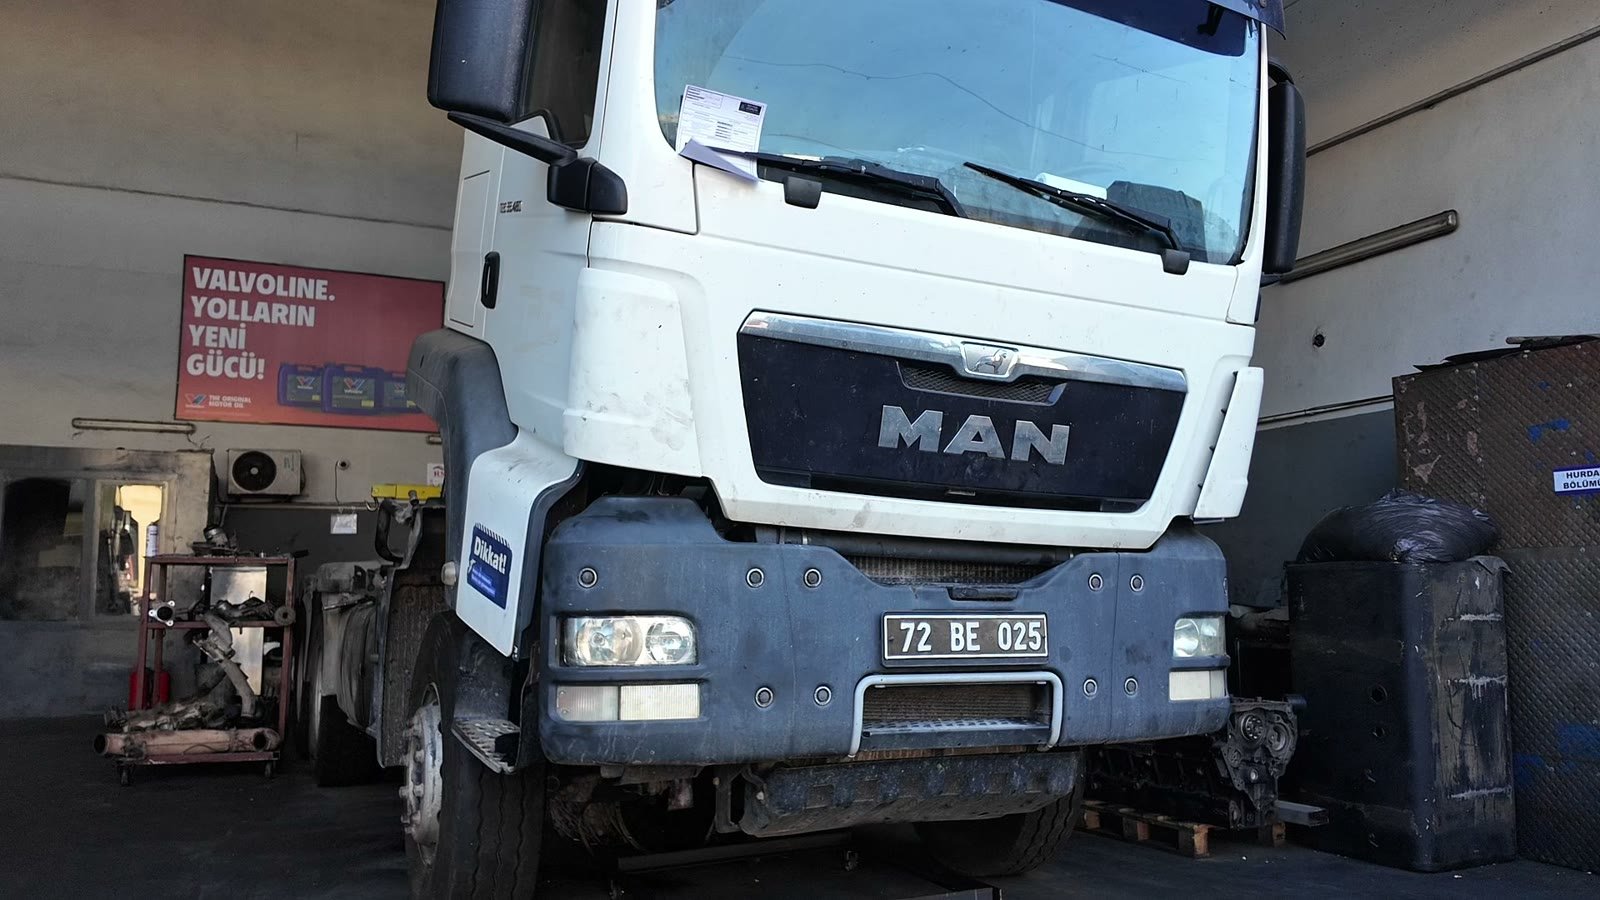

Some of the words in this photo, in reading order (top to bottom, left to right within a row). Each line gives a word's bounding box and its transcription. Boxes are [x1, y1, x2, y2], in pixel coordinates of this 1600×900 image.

[192, 266, 336, 302] VALVOLINE.
[190, 296, 315, 327] YOLLARIN
[188, 322, 247, 350] YENİ
[186, 349, 265, 380] GÜCÜ!
[878, 405, 1070, 465] MAN
[1566, 470, 1600, 479] HURDA
[474, 536, 507, 574] Dikkat!
[900, 622, 932, 653] 72
[950, 621, 981, 652] BE
[997, 621, 1042, 651] 025
